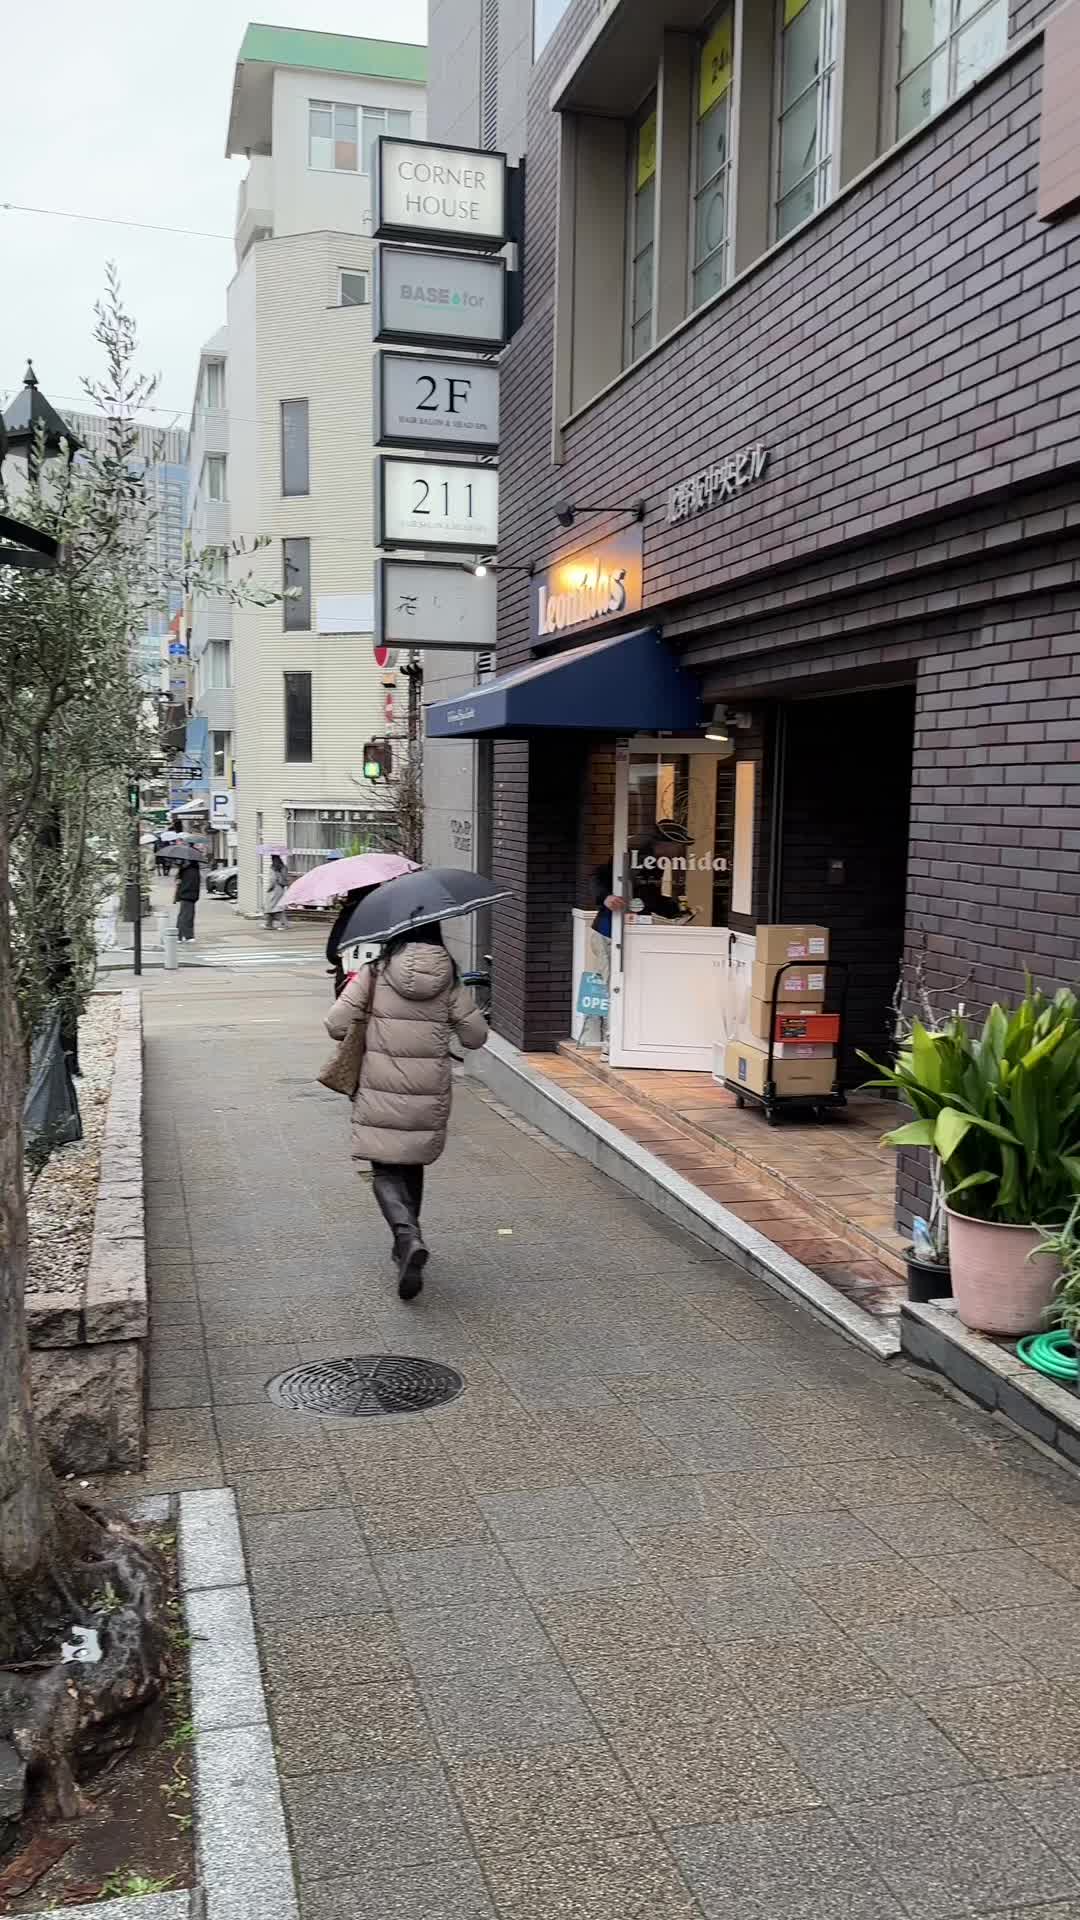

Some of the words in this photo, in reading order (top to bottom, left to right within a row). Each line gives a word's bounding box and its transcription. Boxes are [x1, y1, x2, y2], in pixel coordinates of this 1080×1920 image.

[397, 160, 487, 190] CORNER
[405, 192, 481, 220] HOUSE
[400, 284, 449, 304] BASE
[415, 375, 472, 413] 2F
[412, 478, 474, 518] 211
[213, 794, 229, 812] P
[630, 850, 734, 871] Leonida
[582, 996, 610, 1010] OPE
